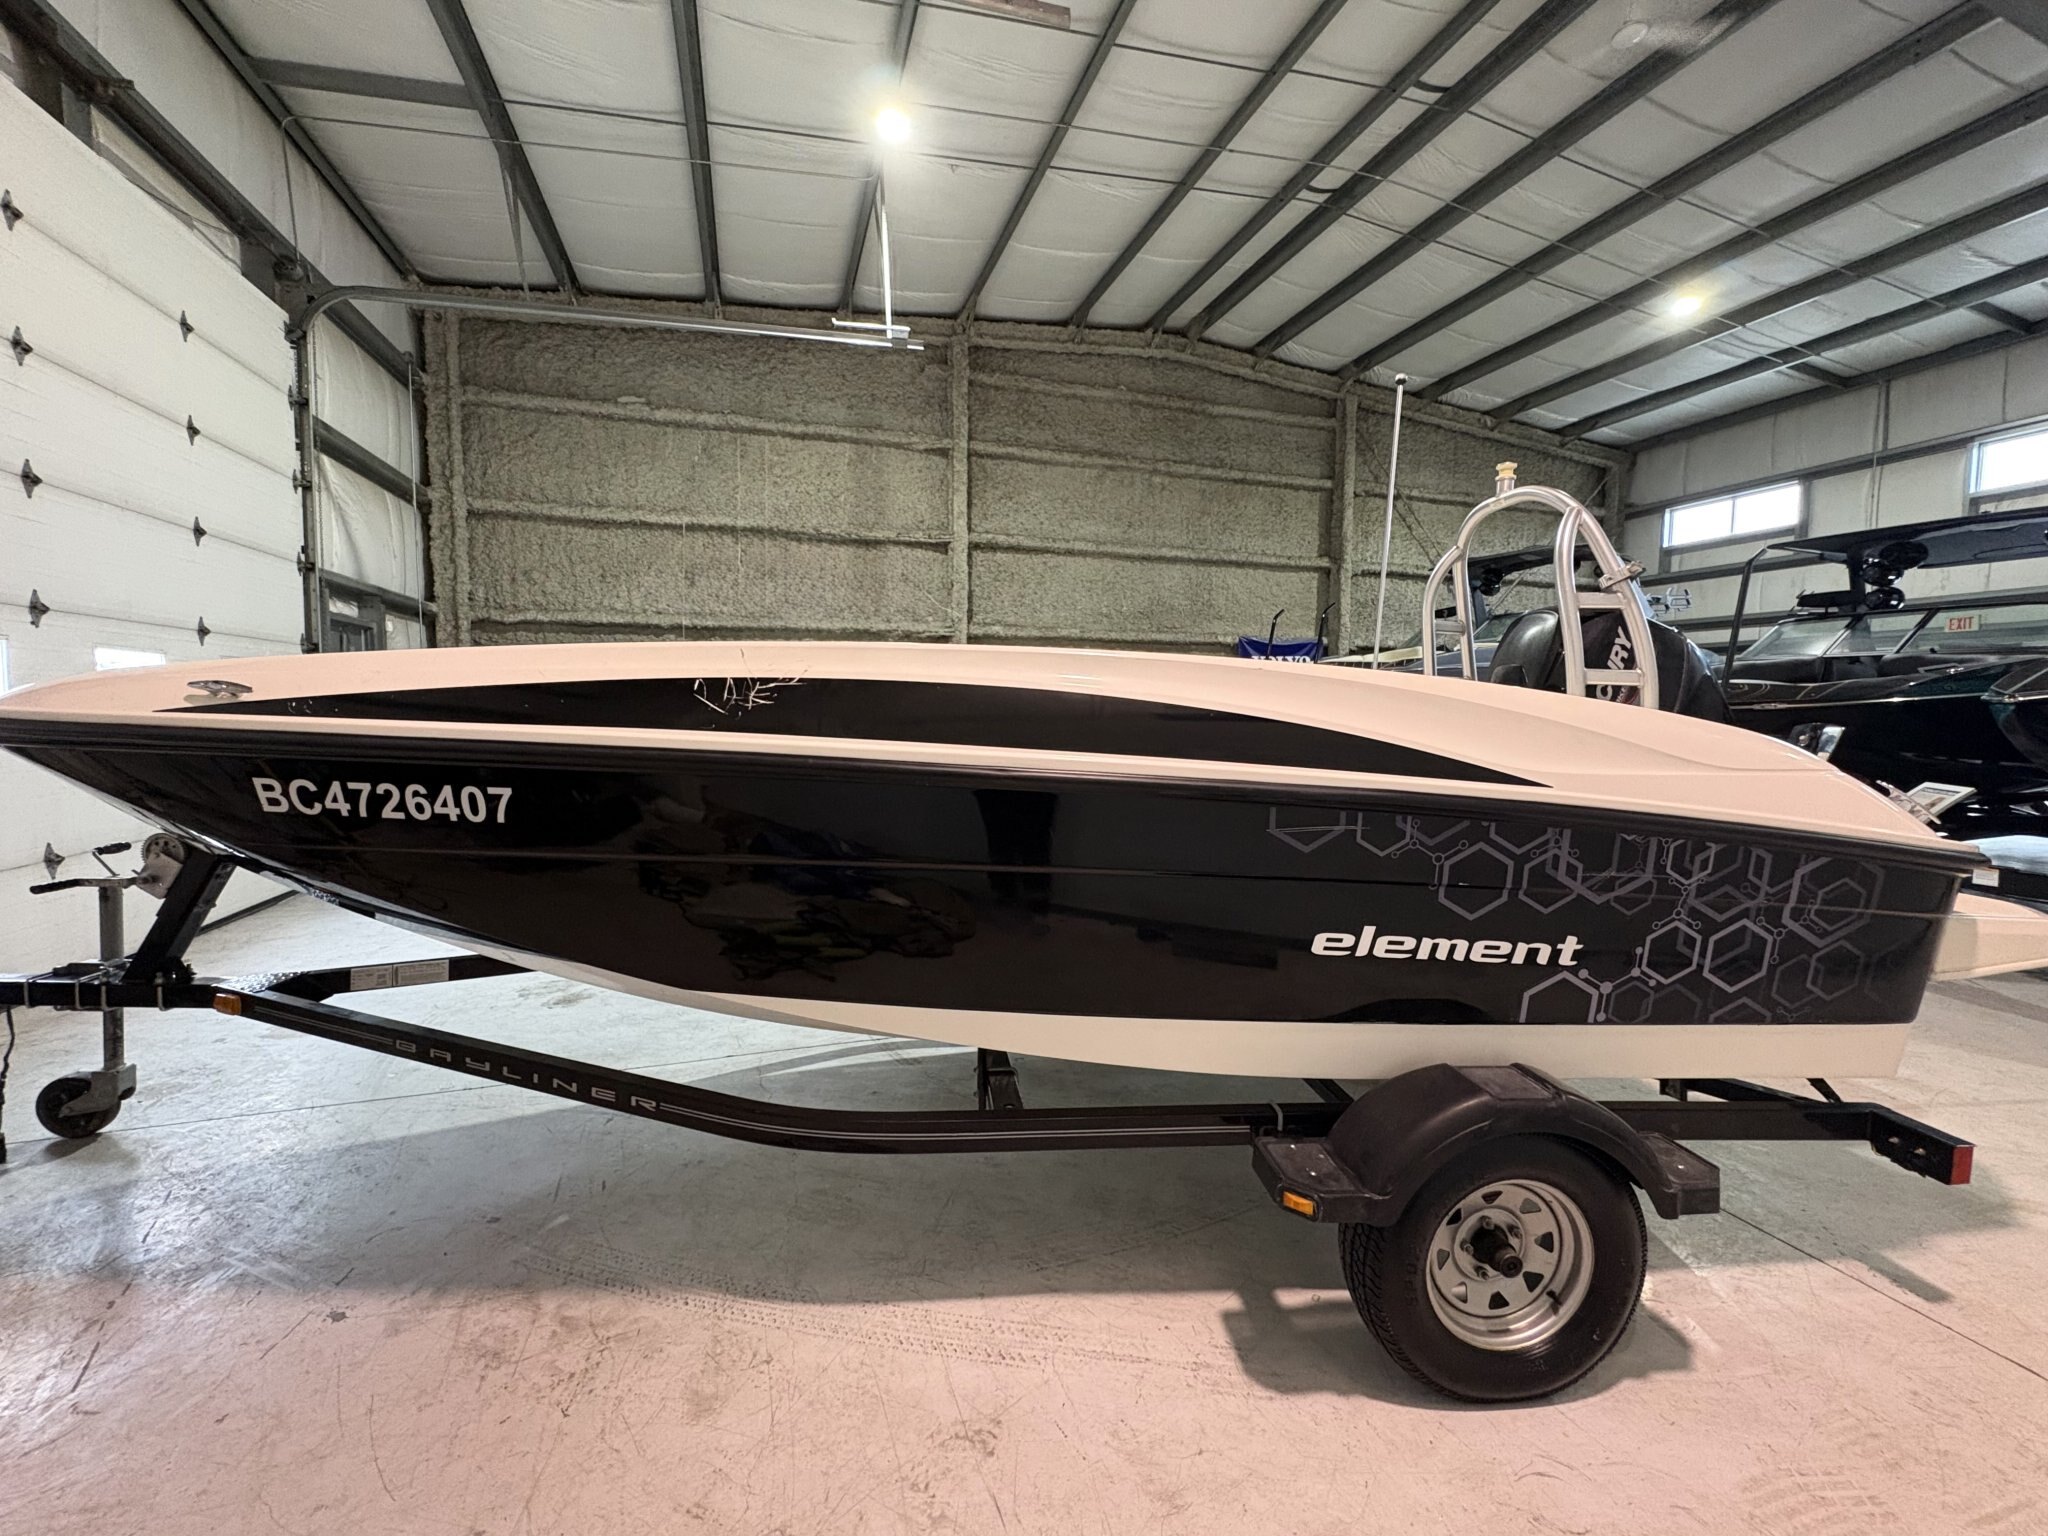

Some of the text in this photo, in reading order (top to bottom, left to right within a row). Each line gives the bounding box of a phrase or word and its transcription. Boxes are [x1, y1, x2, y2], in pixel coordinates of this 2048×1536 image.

[1949, 616, 1975, 630] EXIT
[251, 777, 513, 824] BC4726407
[1310, 925, 1584, 966] element
[395, 1039, 657, 1112] BAYLINER
